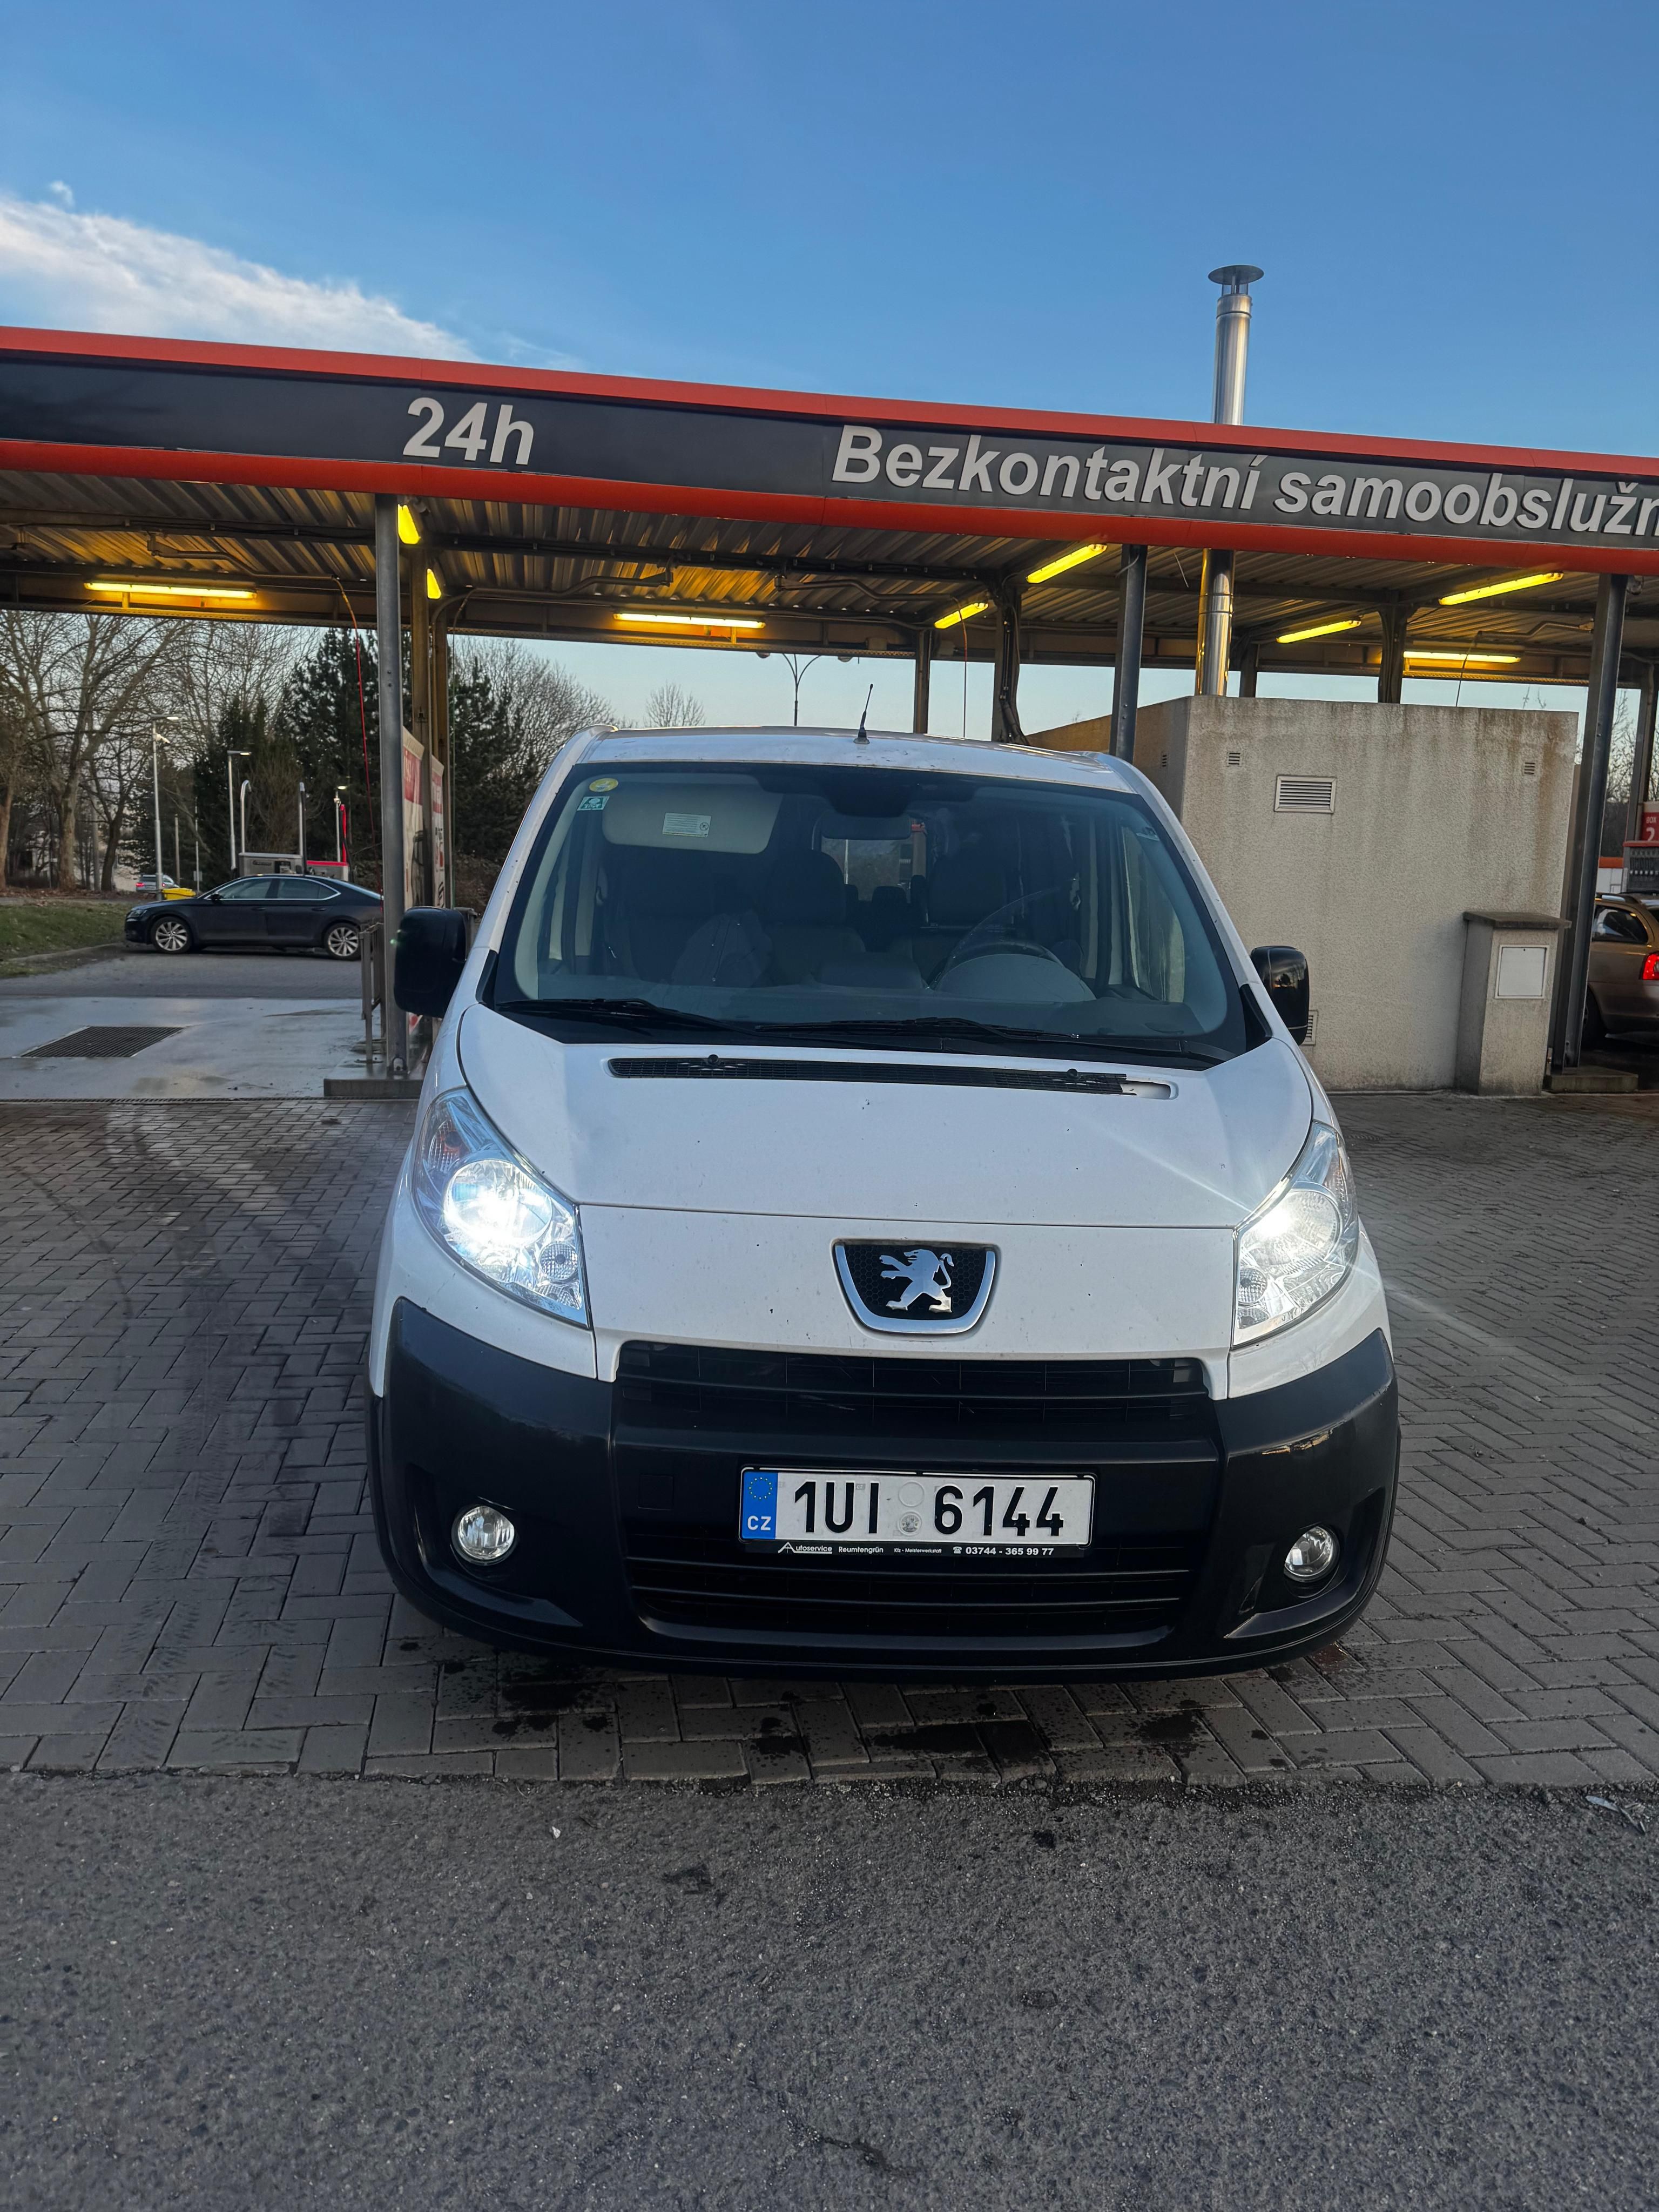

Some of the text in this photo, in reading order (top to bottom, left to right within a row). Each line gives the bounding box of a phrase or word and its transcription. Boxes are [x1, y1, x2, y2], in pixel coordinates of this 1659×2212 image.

[403, 397, 534, 465] 24h
[831, 424, 1659, 536] Bezkontaktní samoobslužn
[747, 1515, 772, 1532] CZ
[794, 1481, 1064, 1536] 1UI 6144
[778, 1542, 832, 1554] Autoservice
[838, 1546, 884, 1554] Reumtengrün
[965, 1547, 996, 1555] 03744
